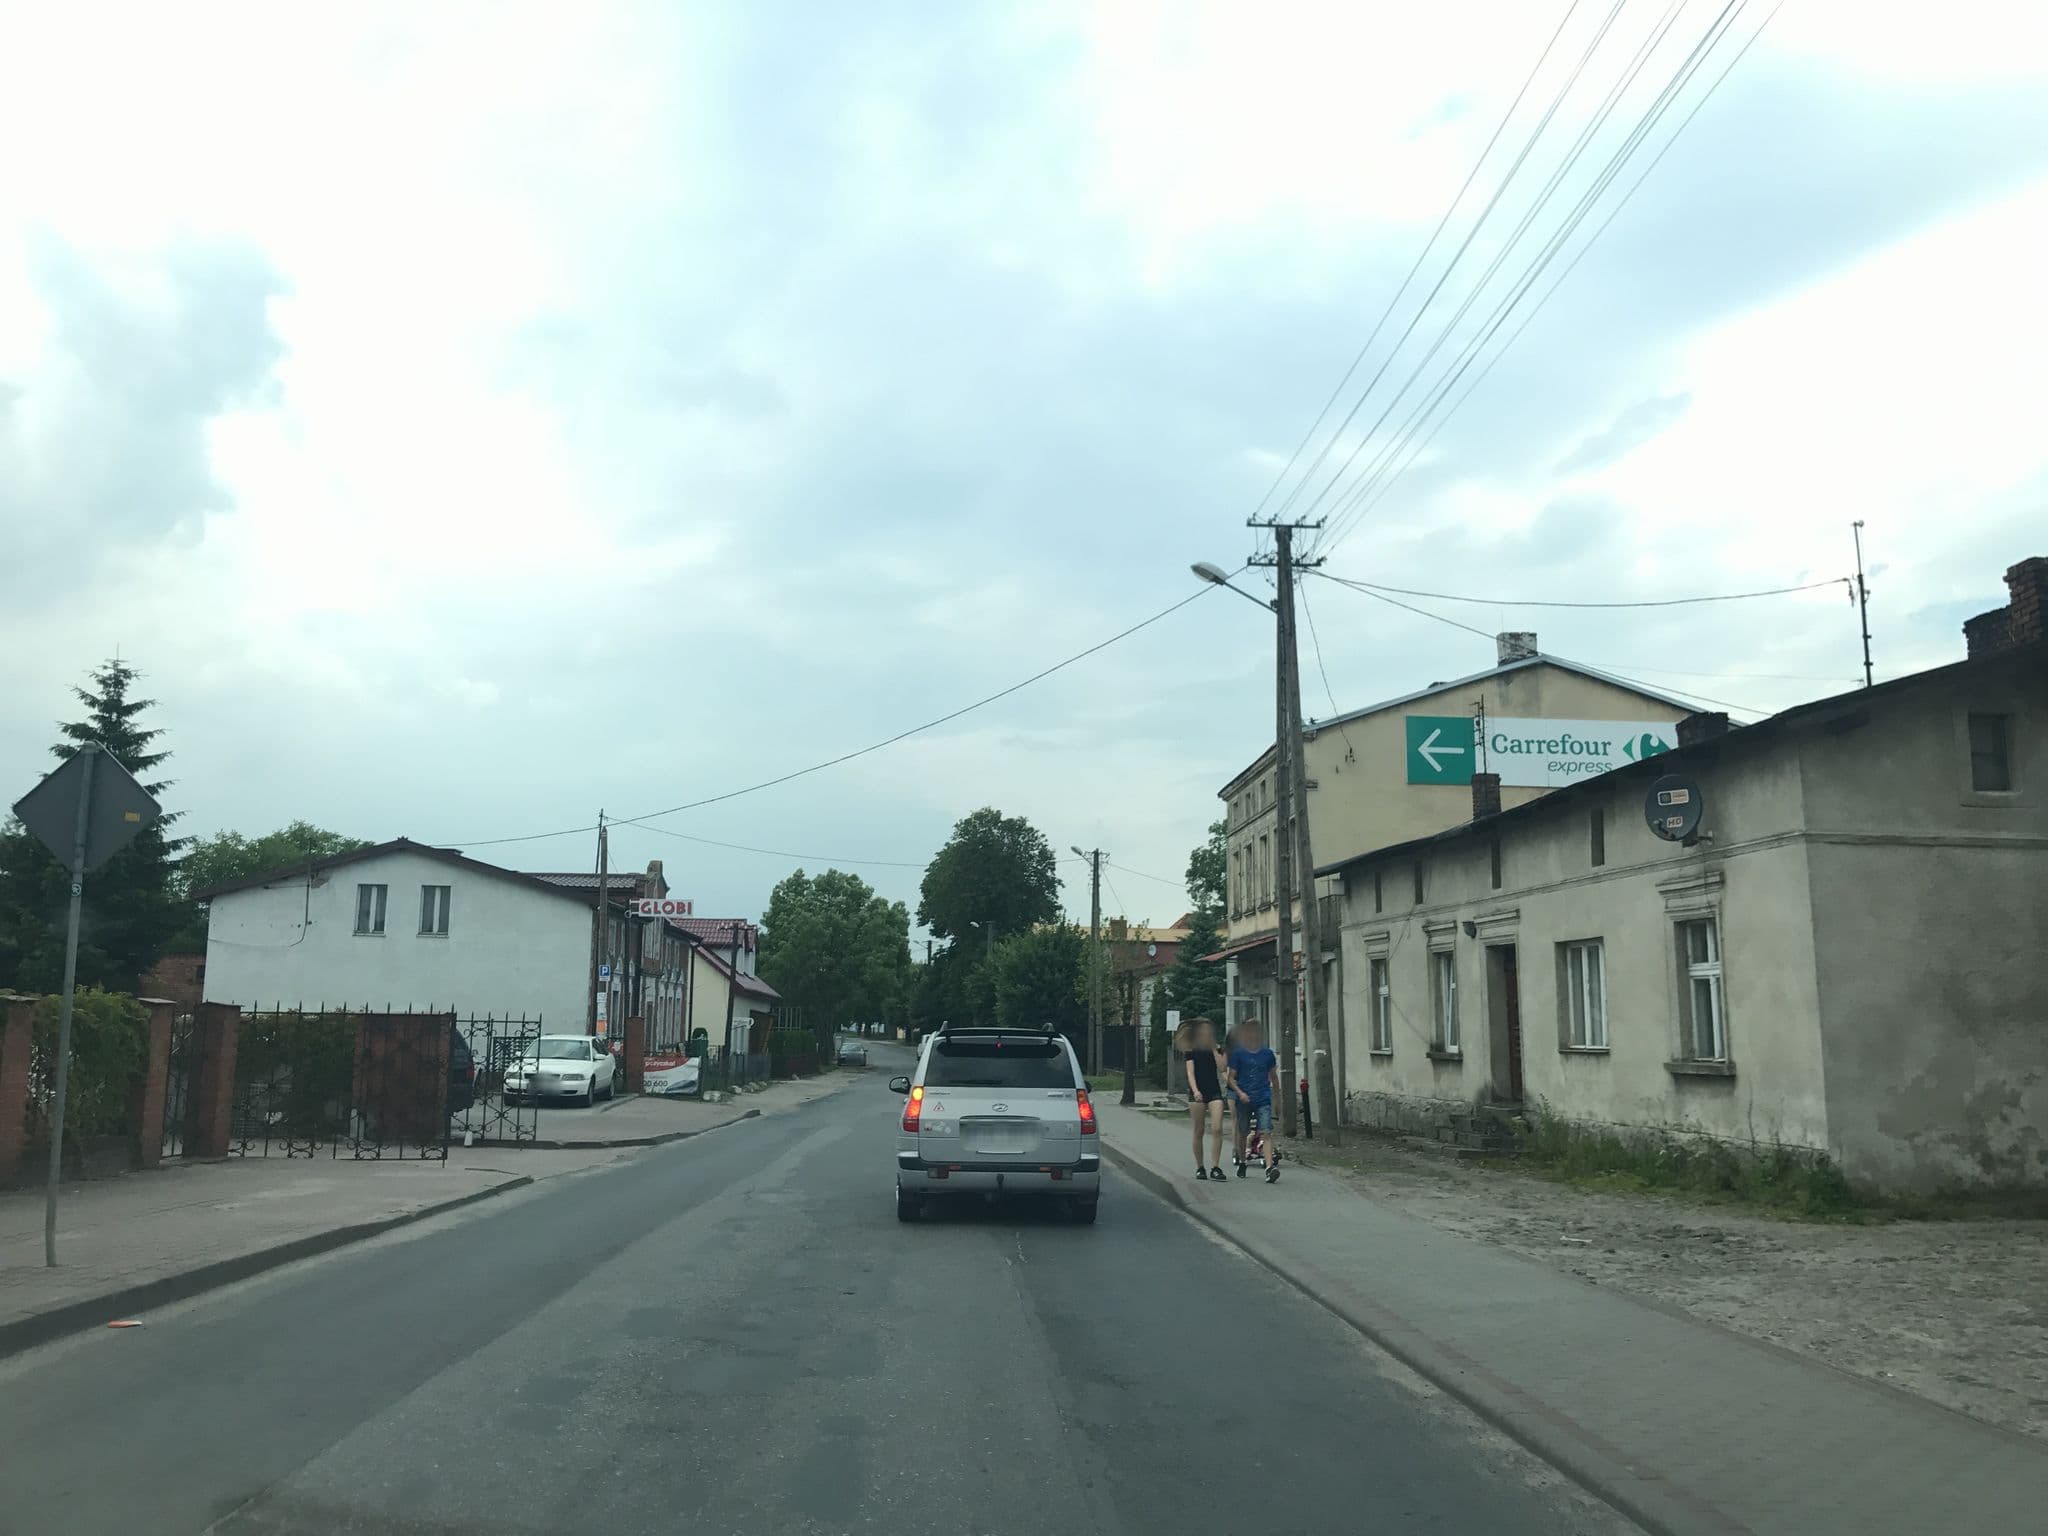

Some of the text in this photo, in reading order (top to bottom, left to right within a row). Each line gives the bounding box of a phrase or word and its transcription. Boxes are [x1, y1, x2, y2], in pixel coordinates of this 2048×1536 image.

[1491, 733, 1612, 756] Carrefour
[1547, 760, 1613, 775] express
[640, 900, 692, 915] GLOBI
